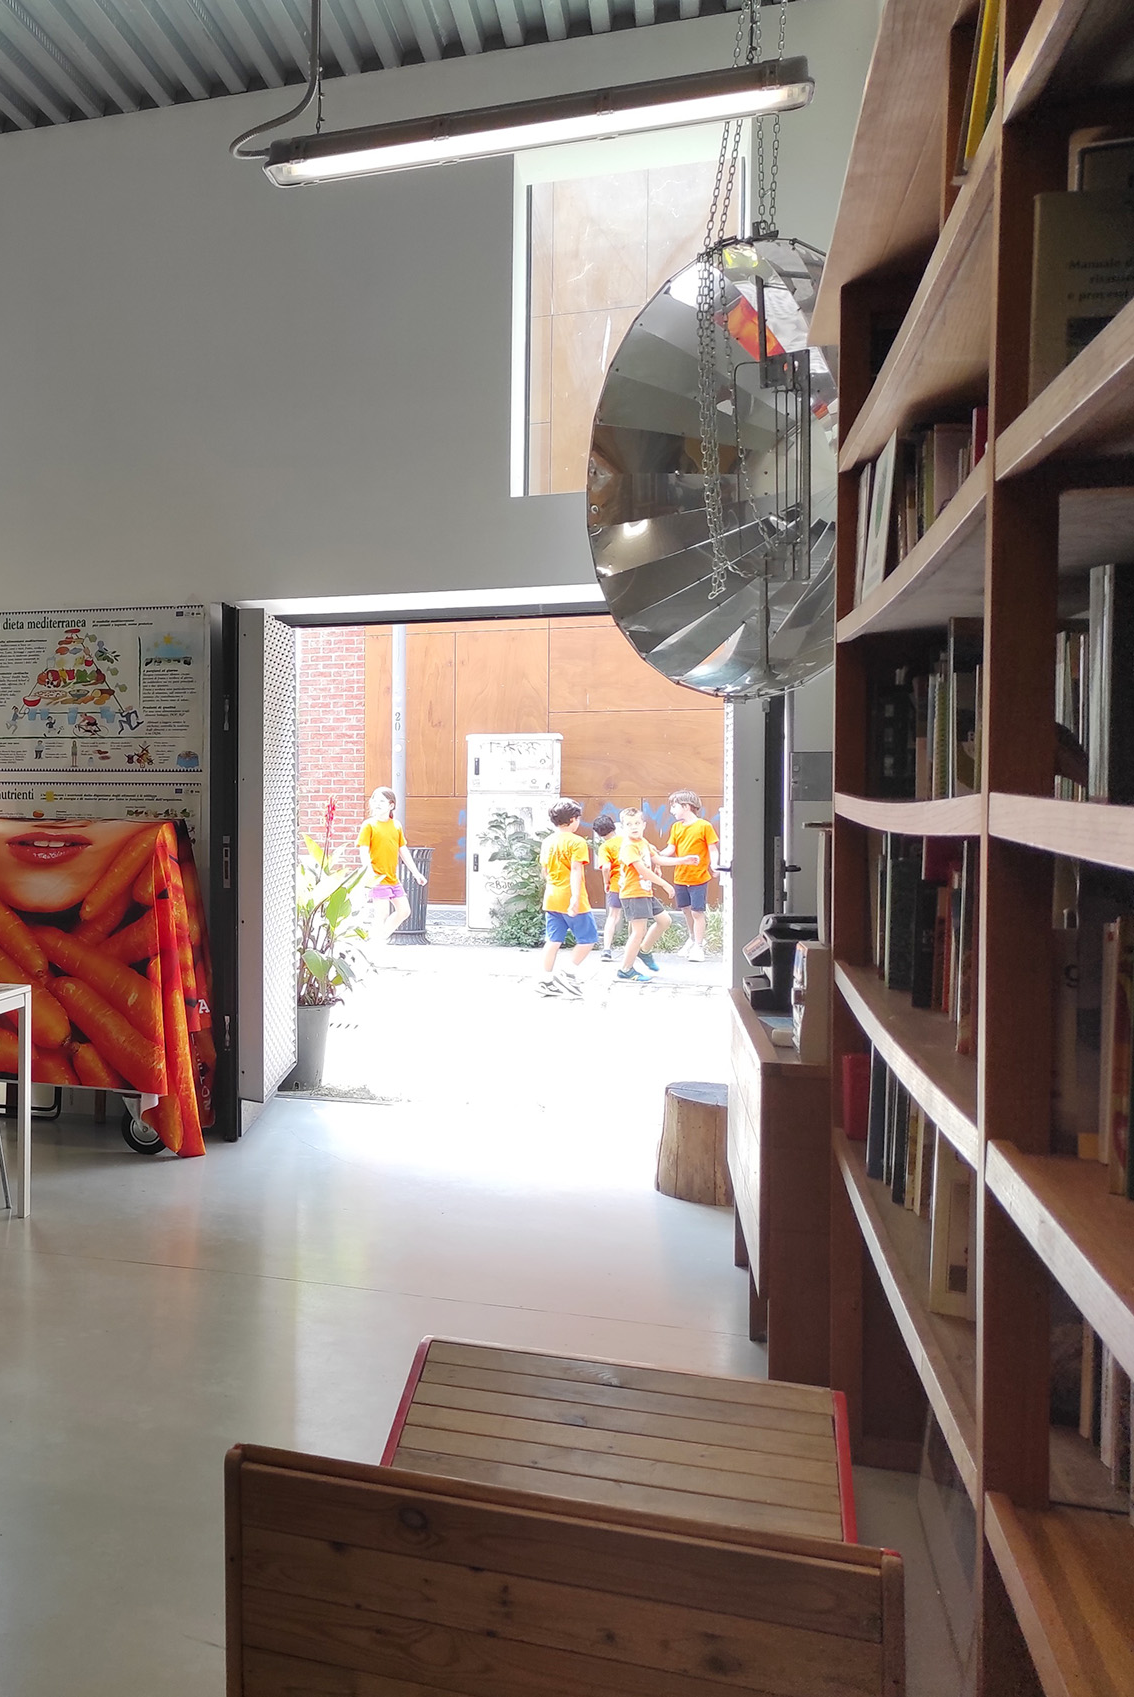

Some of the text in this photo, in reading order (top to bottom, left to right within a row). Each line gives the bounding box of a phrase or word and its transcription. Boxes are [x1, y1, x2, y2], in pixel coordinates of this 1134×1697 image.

[3, 618, 24, 630] dieta
[27, 616, 86, 630] mediterranea
[394, 711, 401, 731] 20
